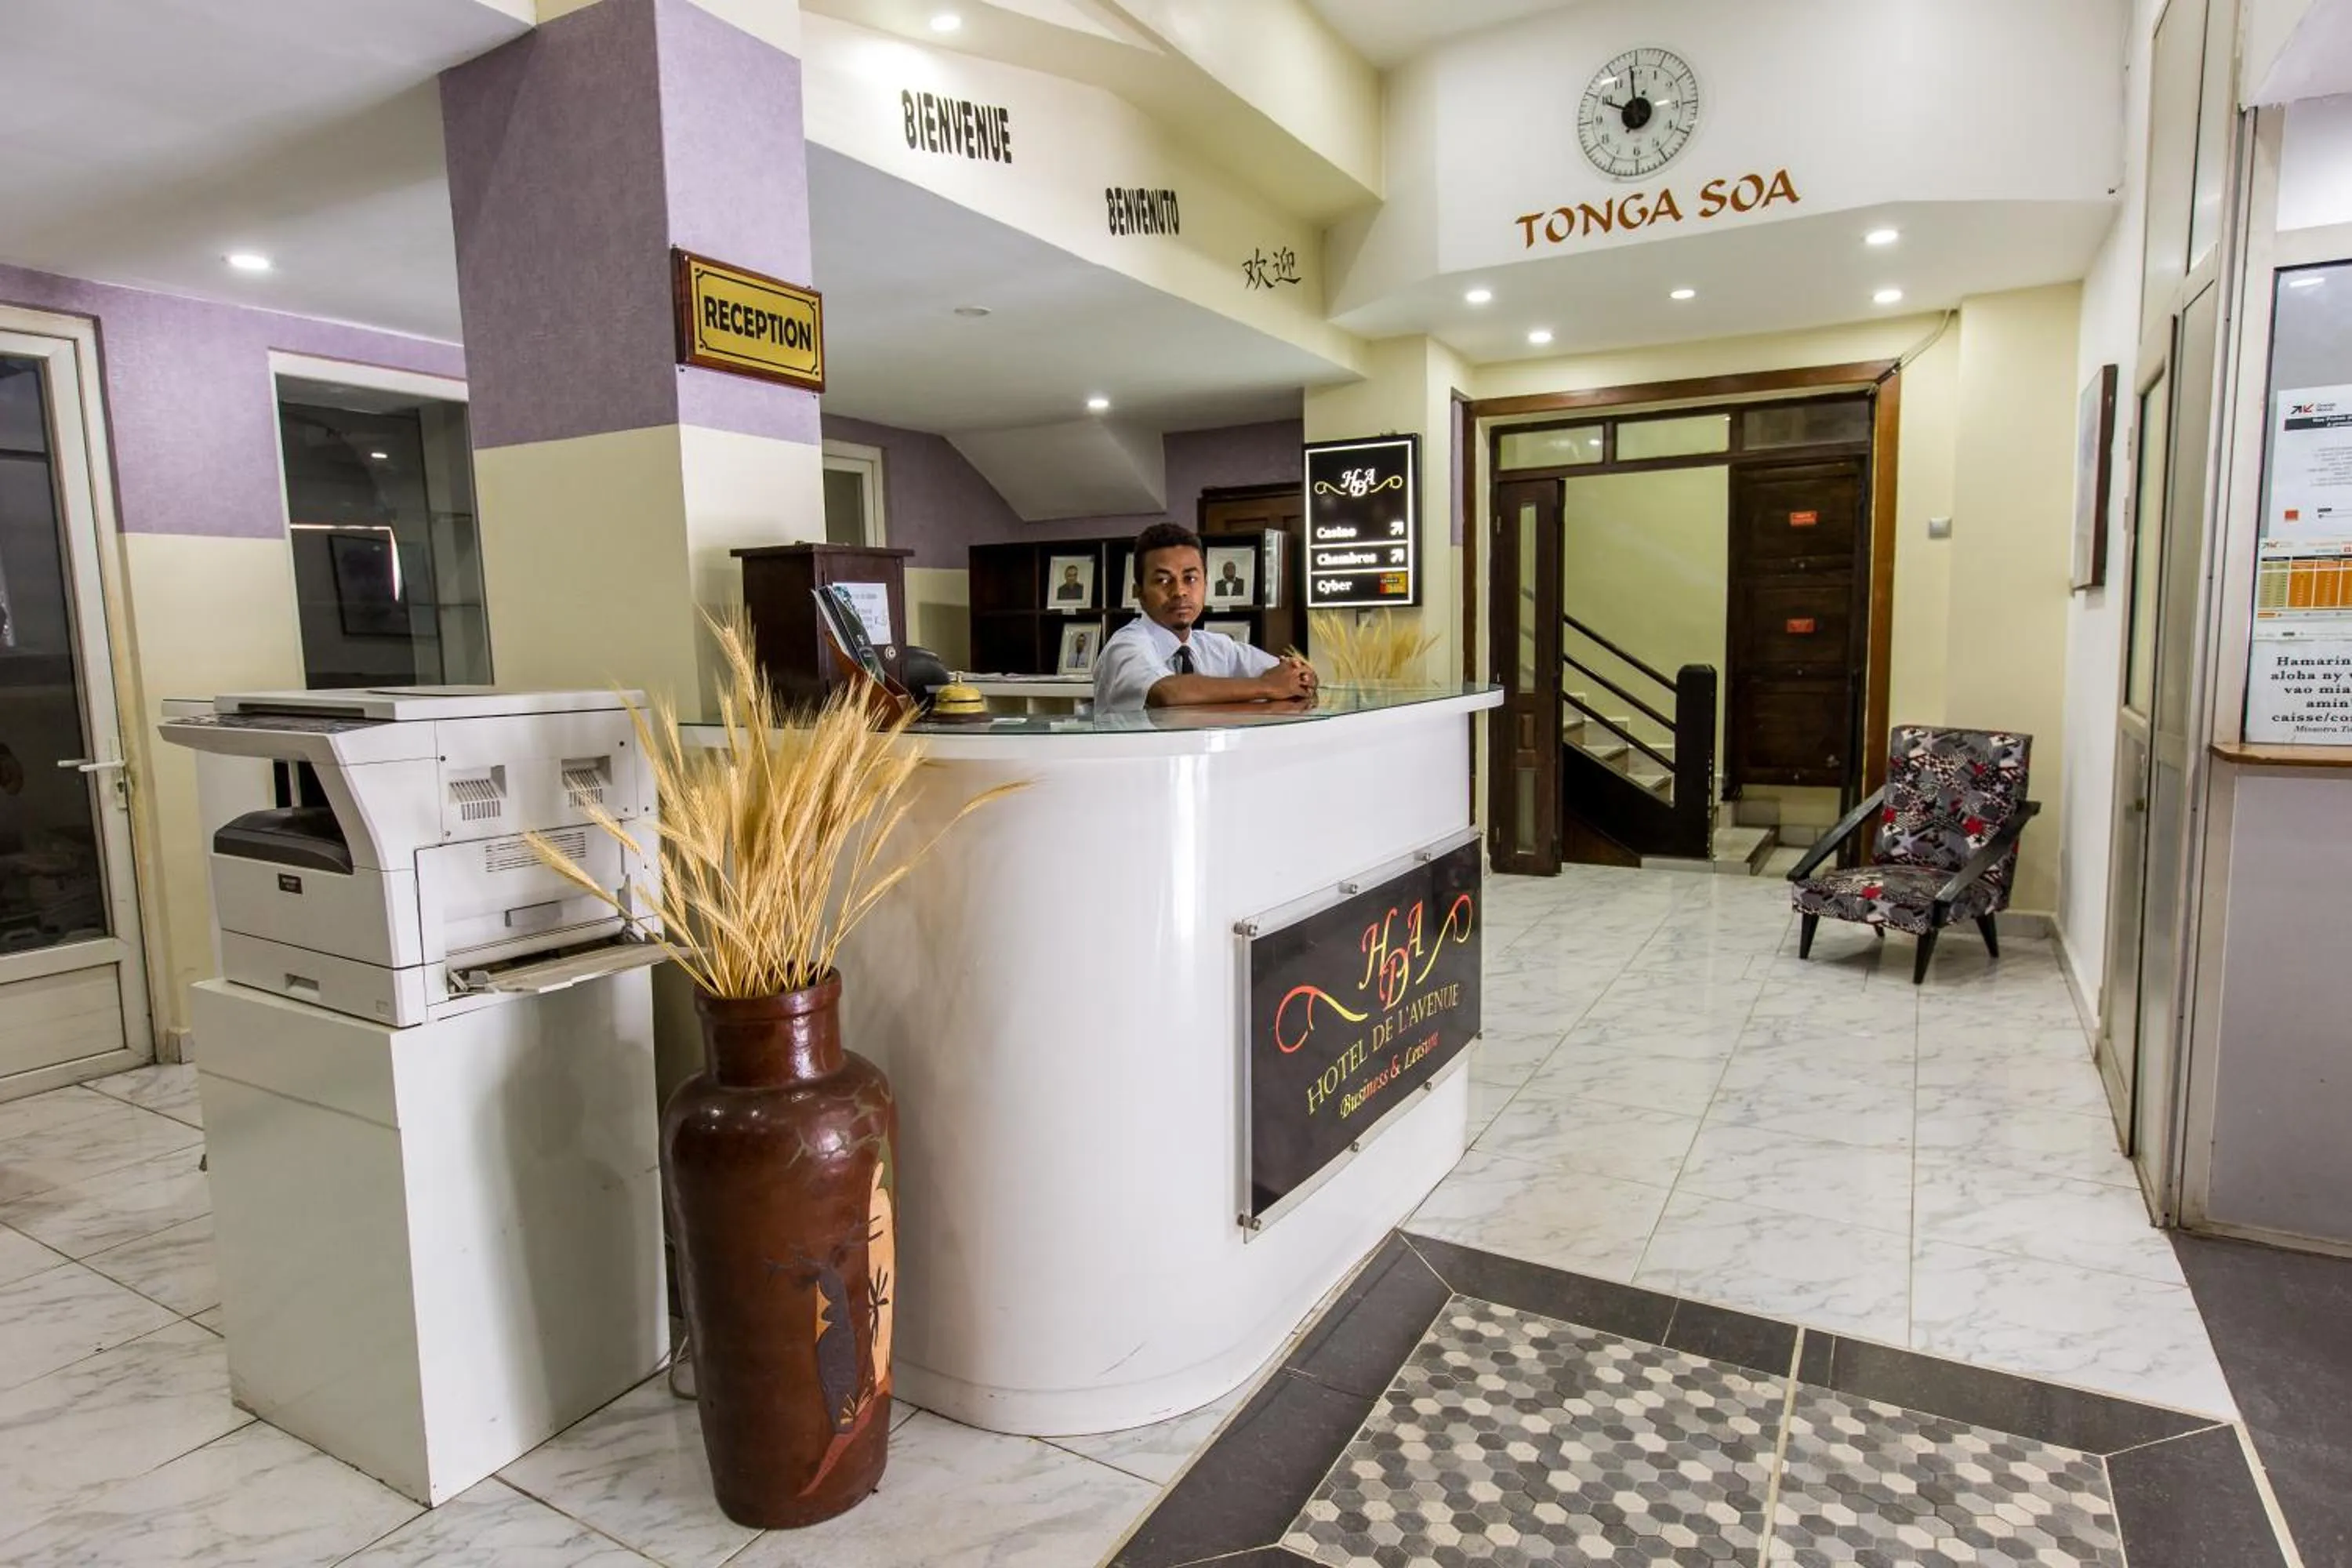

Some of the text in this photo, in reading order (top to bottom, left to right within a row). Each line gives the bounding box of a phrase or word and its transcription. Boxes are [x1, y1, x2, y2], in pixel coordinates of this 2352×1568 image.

[902, 89, 1012, 164] BIENVENUE
[1105, 187, 1179, 236] BENVENUTO
[1515, 169, 1802, 249] TONGA SOA
[1242, 246, 1301, 289] 欢迎
[703, 295, 811, 351] RECEPTION
[1316, 526, 1357, 539] Casino
[1316, 551, 1377, 565] Chambres
[1316, 579, 1352, 594] Cyber
[2270, 670, 2316, 680] aloha
[2322, 673, 2343, 683] ny
[1306, 983, 1460, 1116] HOTEL DE L'AVENUE
[1340, 1069, 1389, 1119] Business
[1390, 1054, 1402, 1079] &
